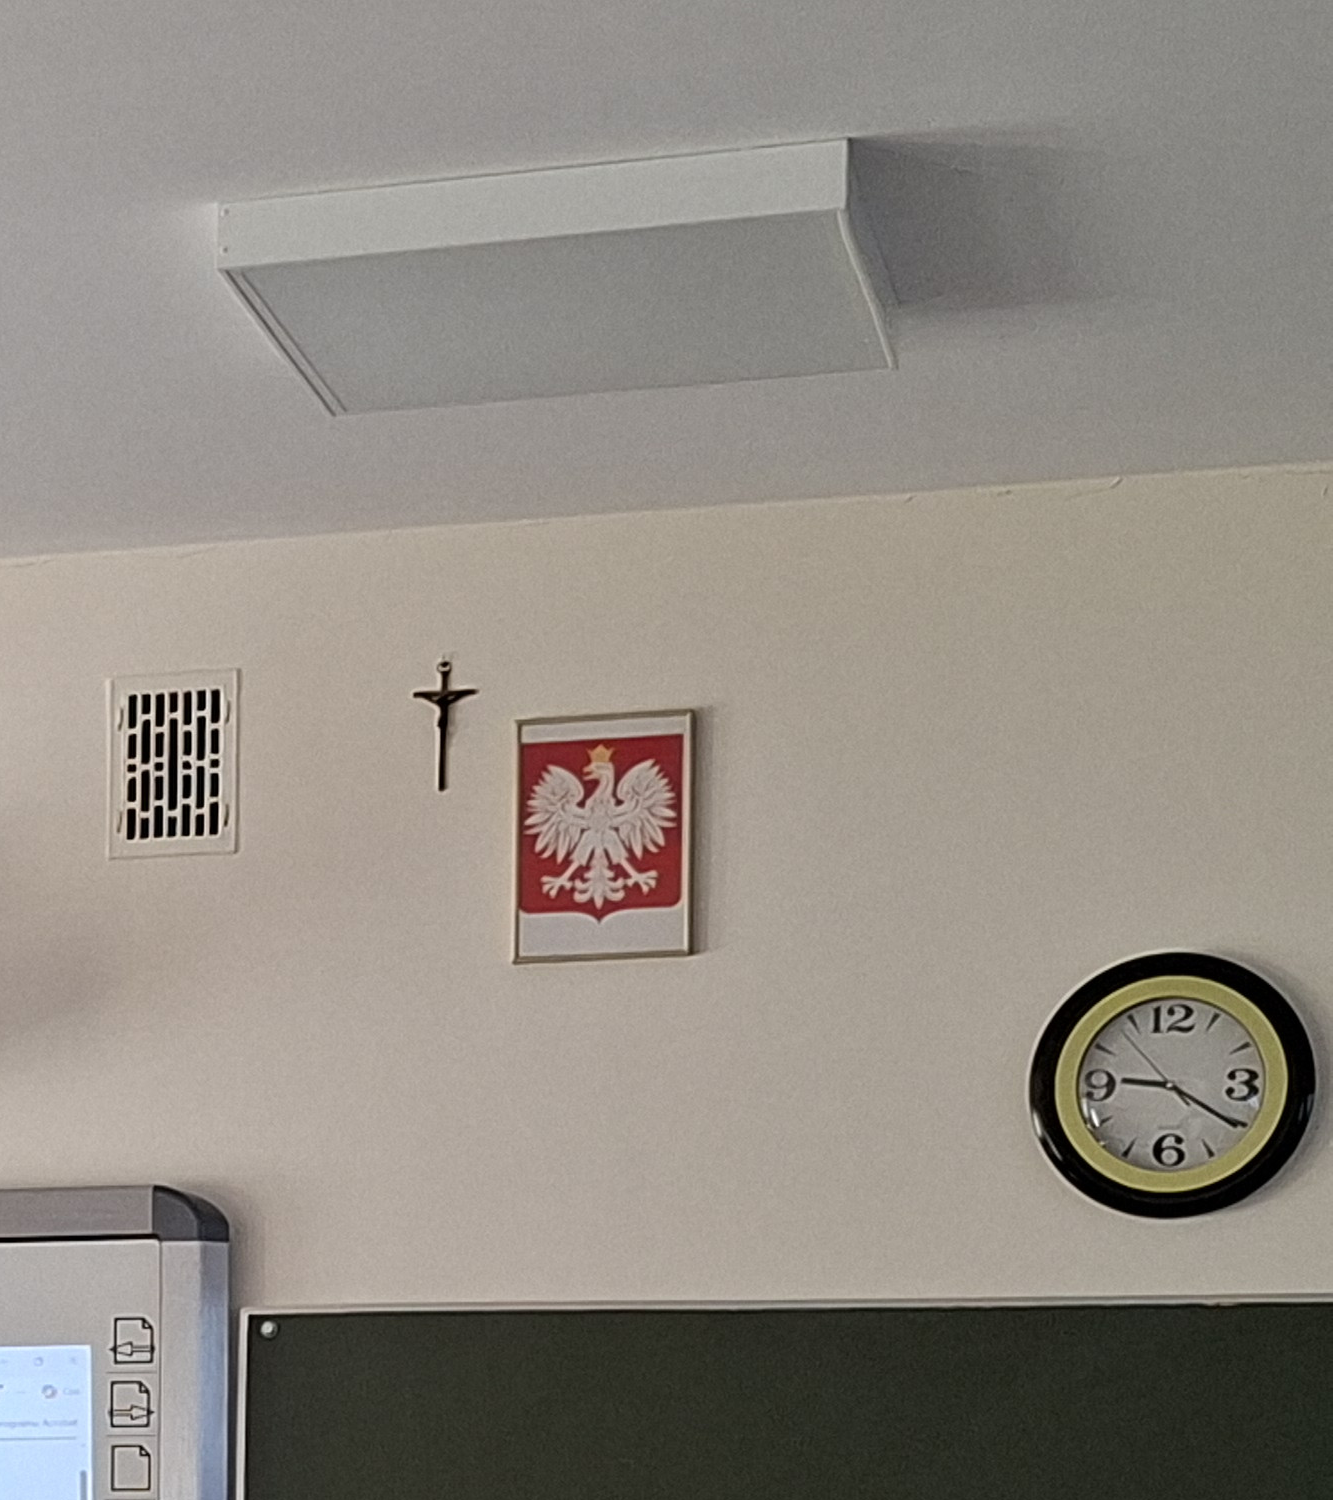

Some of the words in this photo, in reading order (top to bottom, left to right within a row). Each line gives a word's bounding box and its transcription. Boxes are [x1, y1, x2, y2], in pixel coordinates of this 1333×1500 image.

[1151, 1003, 1196, 1034] 12
[1084, 1068, 1117, 1102] 9
[1224, 1068, 1260, 1102] 3
[1152, 1133, 1185, 1167] 6
